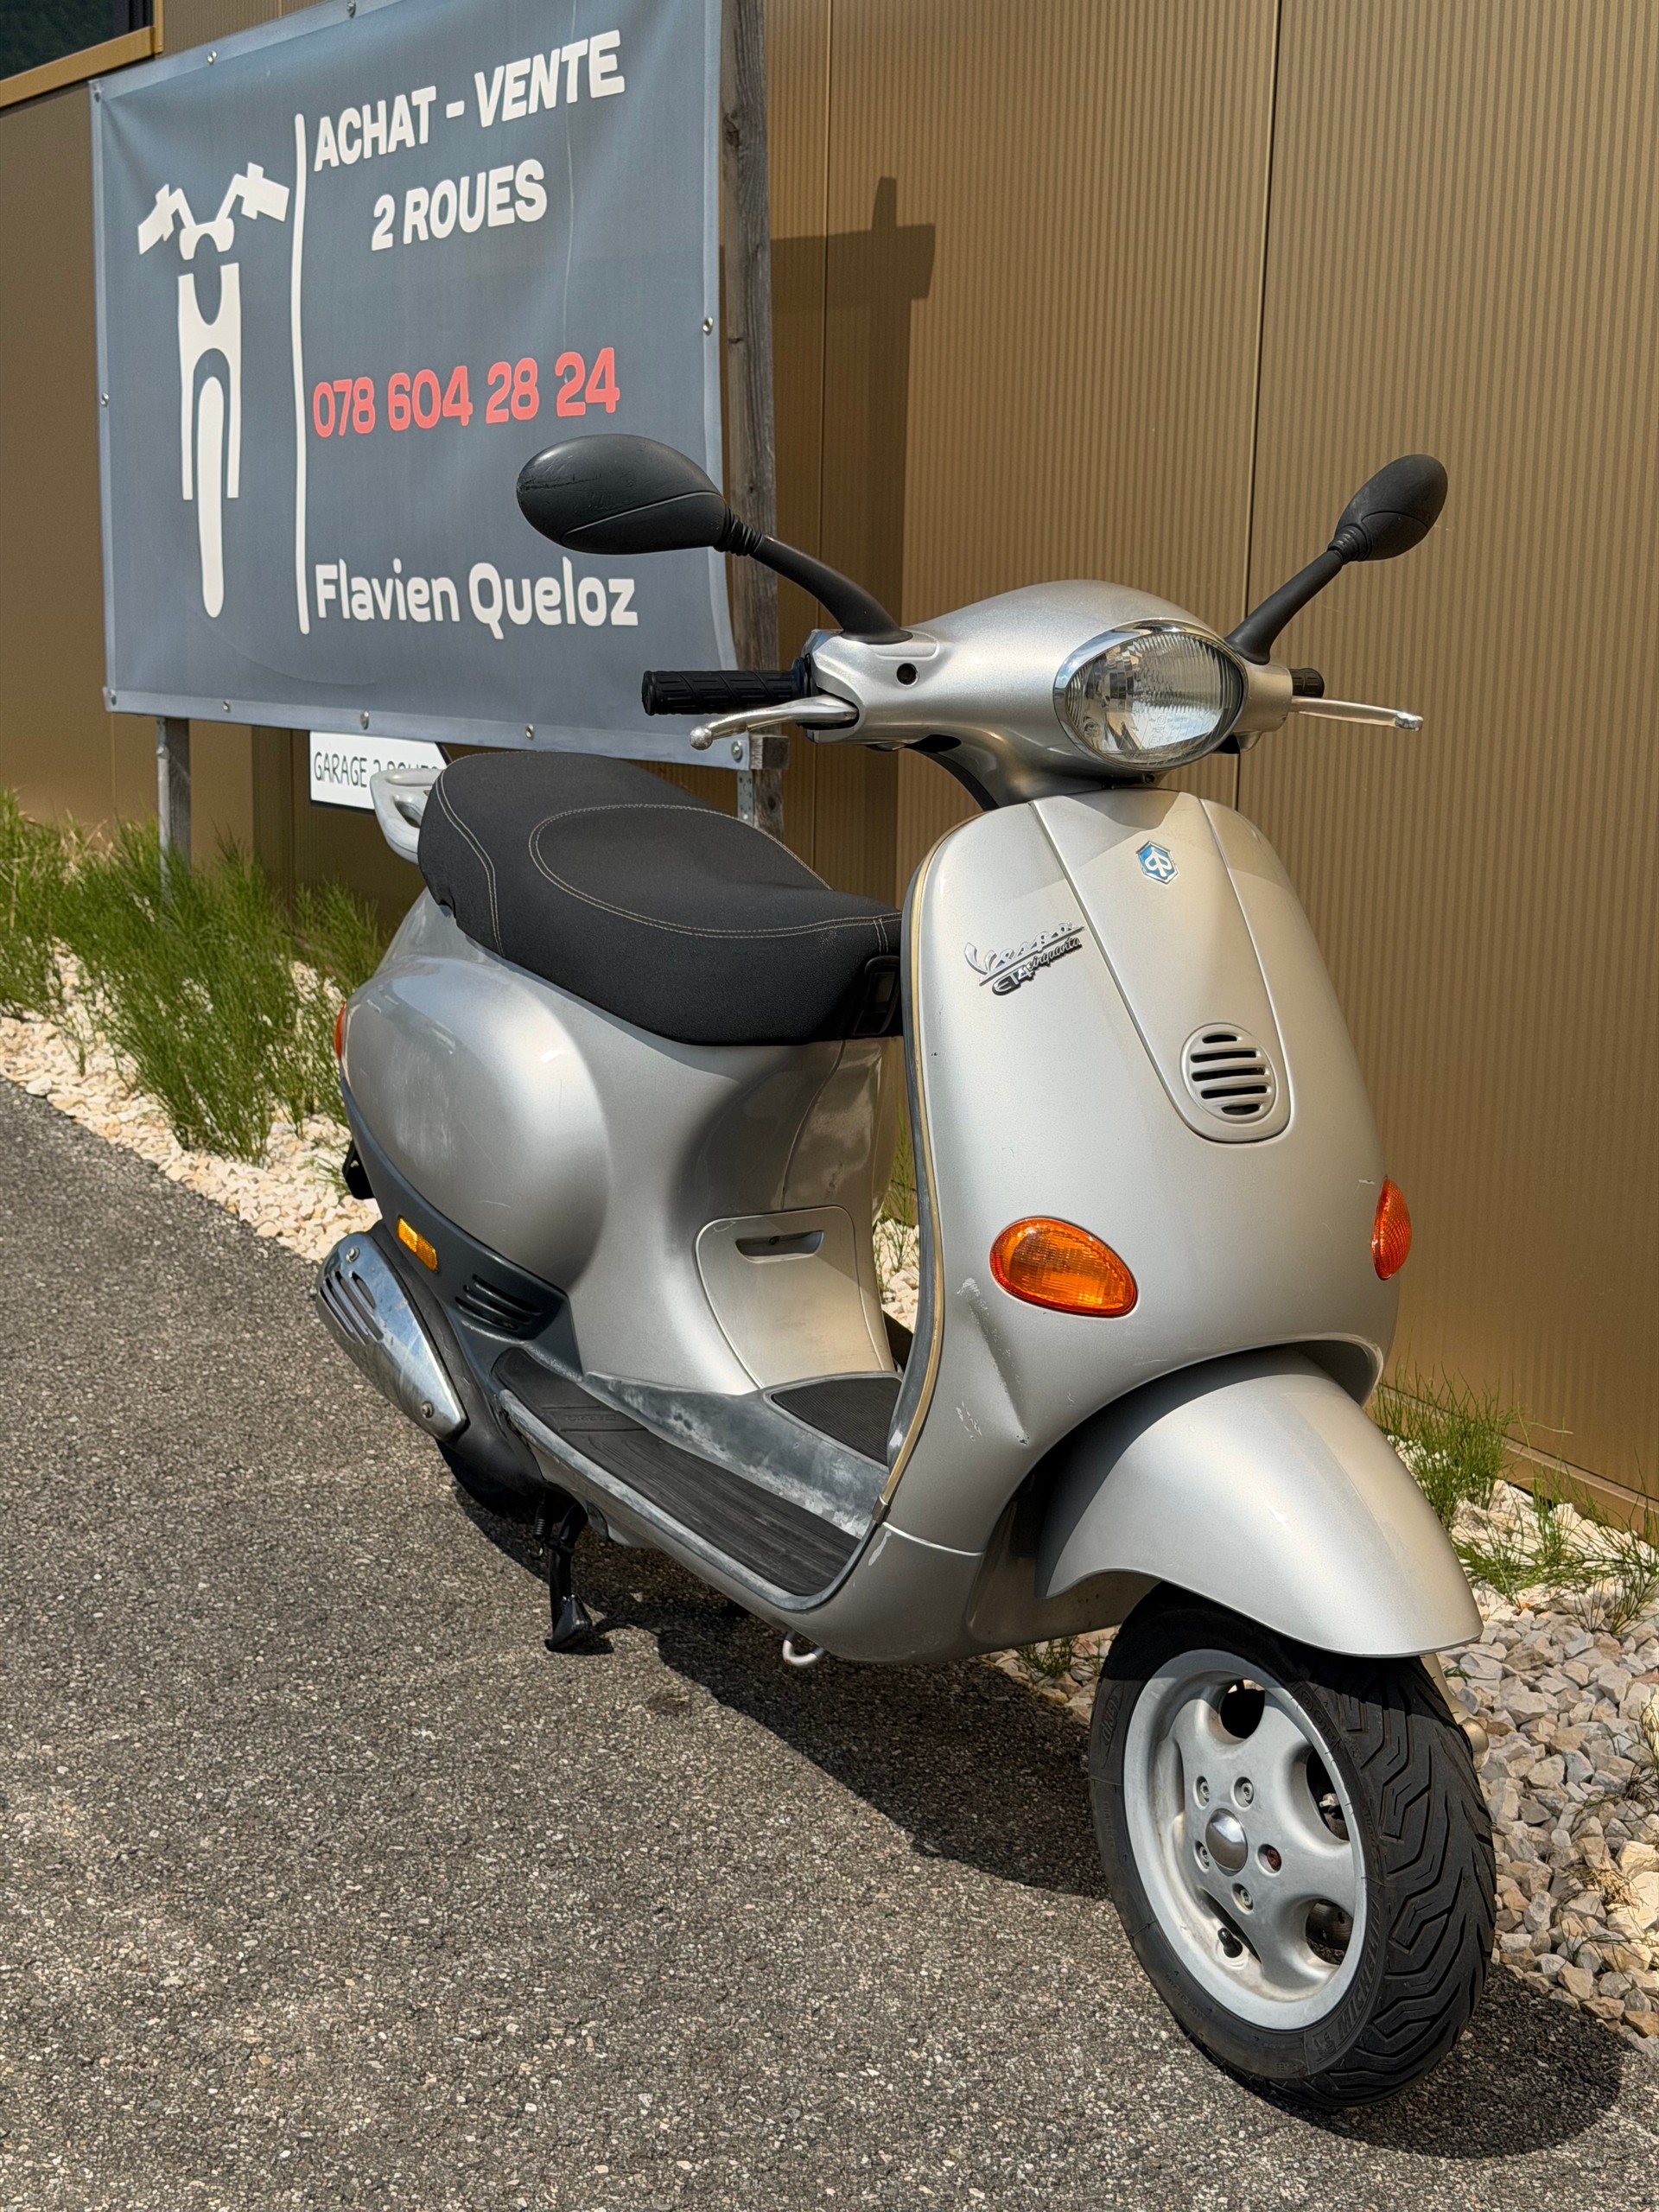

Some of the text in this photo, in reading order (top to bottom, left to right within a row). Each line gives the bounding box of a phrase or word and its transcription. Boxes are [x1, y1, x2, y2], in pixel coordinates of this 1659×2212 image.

[314, 29, 626, 172] ACHAT - VENTE
[371, 158, 548, 251] 2 ROUES
[313, 347, 620, 438] 078 604 28 24
[315, 556, 639, 639] Flavien Queloz
[314, 751, 368, 788] GARAGE
